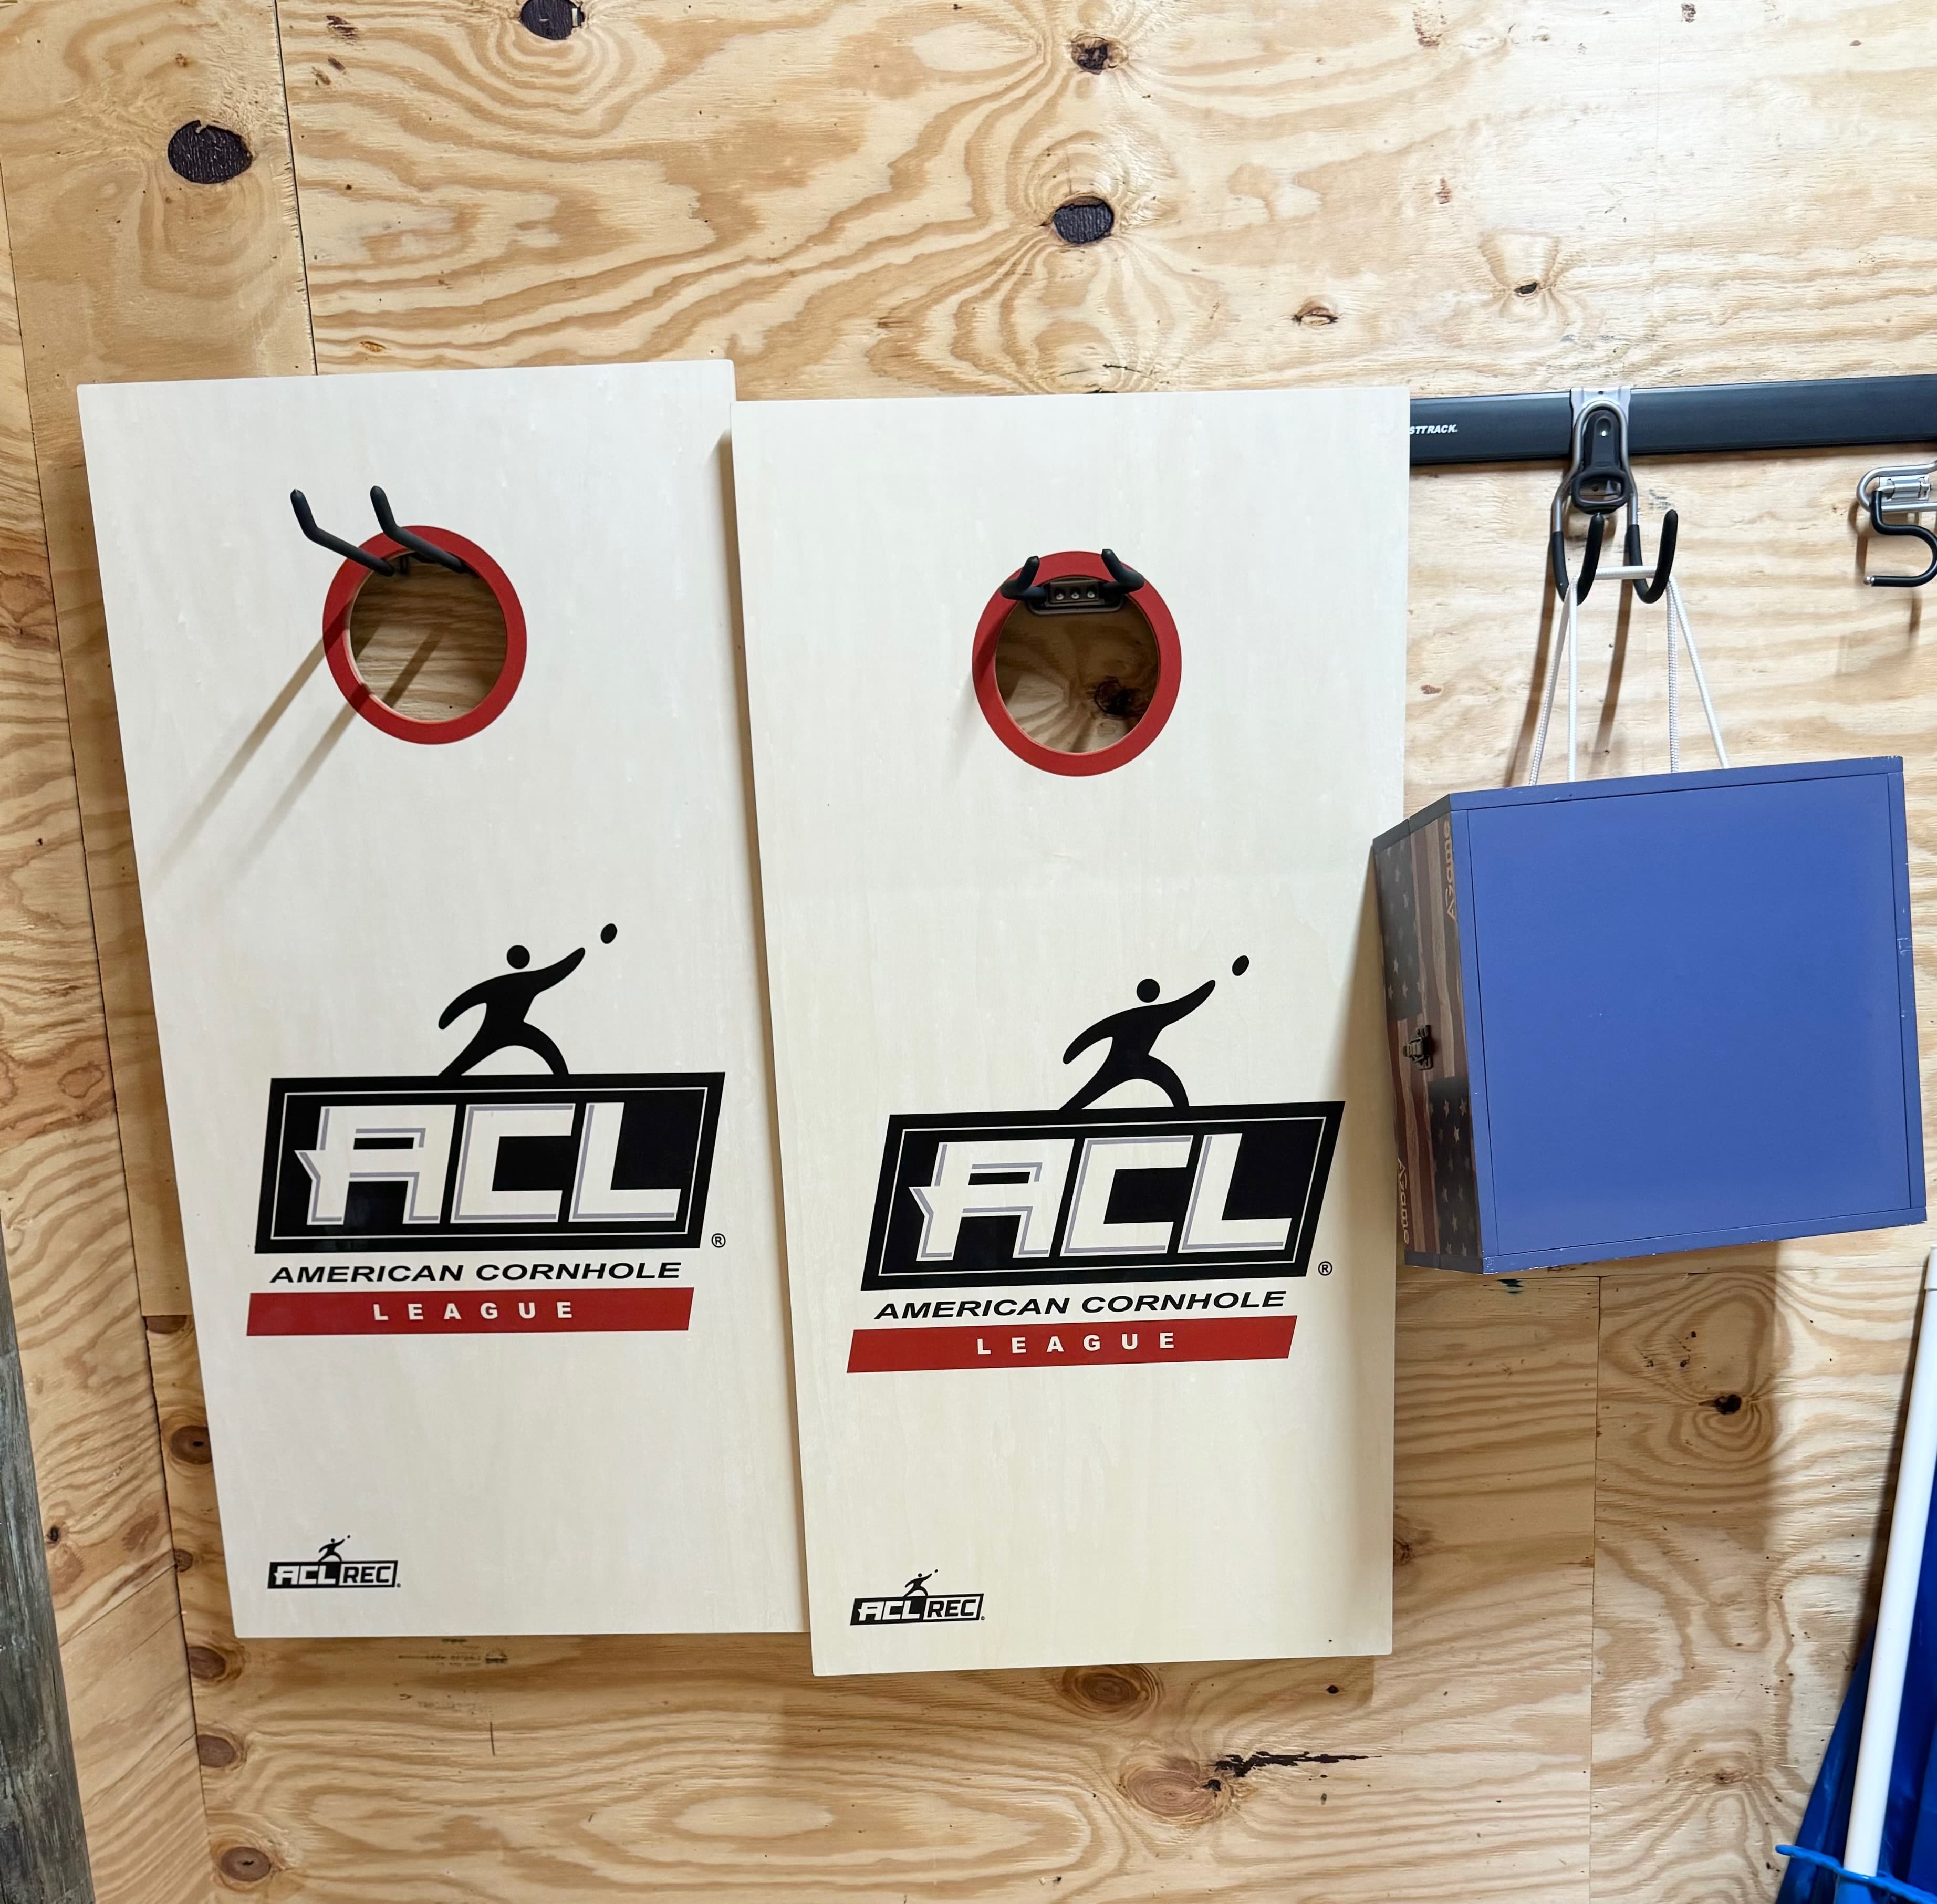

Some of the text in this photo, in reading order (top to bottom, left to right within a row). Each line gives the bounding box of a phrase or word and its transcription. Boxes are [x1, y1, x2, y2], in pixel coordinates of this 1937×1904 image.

[295, 1102, 681, 1225] ACL
[909, 1133, 1293, 1262] ACL
[269, 1262, 682, 1284] AMERICAN CORNHOLE
[372, 1301, 573, 1322] LEAGUE
[874, 1290, 1287, 1320] AMERICAN CORNHOLE
[977, 1331, 1175, 1356] LEAGUE
[274, 1565, 391, 1585] ACL REC
[858, 1599, 977, 1621] ACL REC
